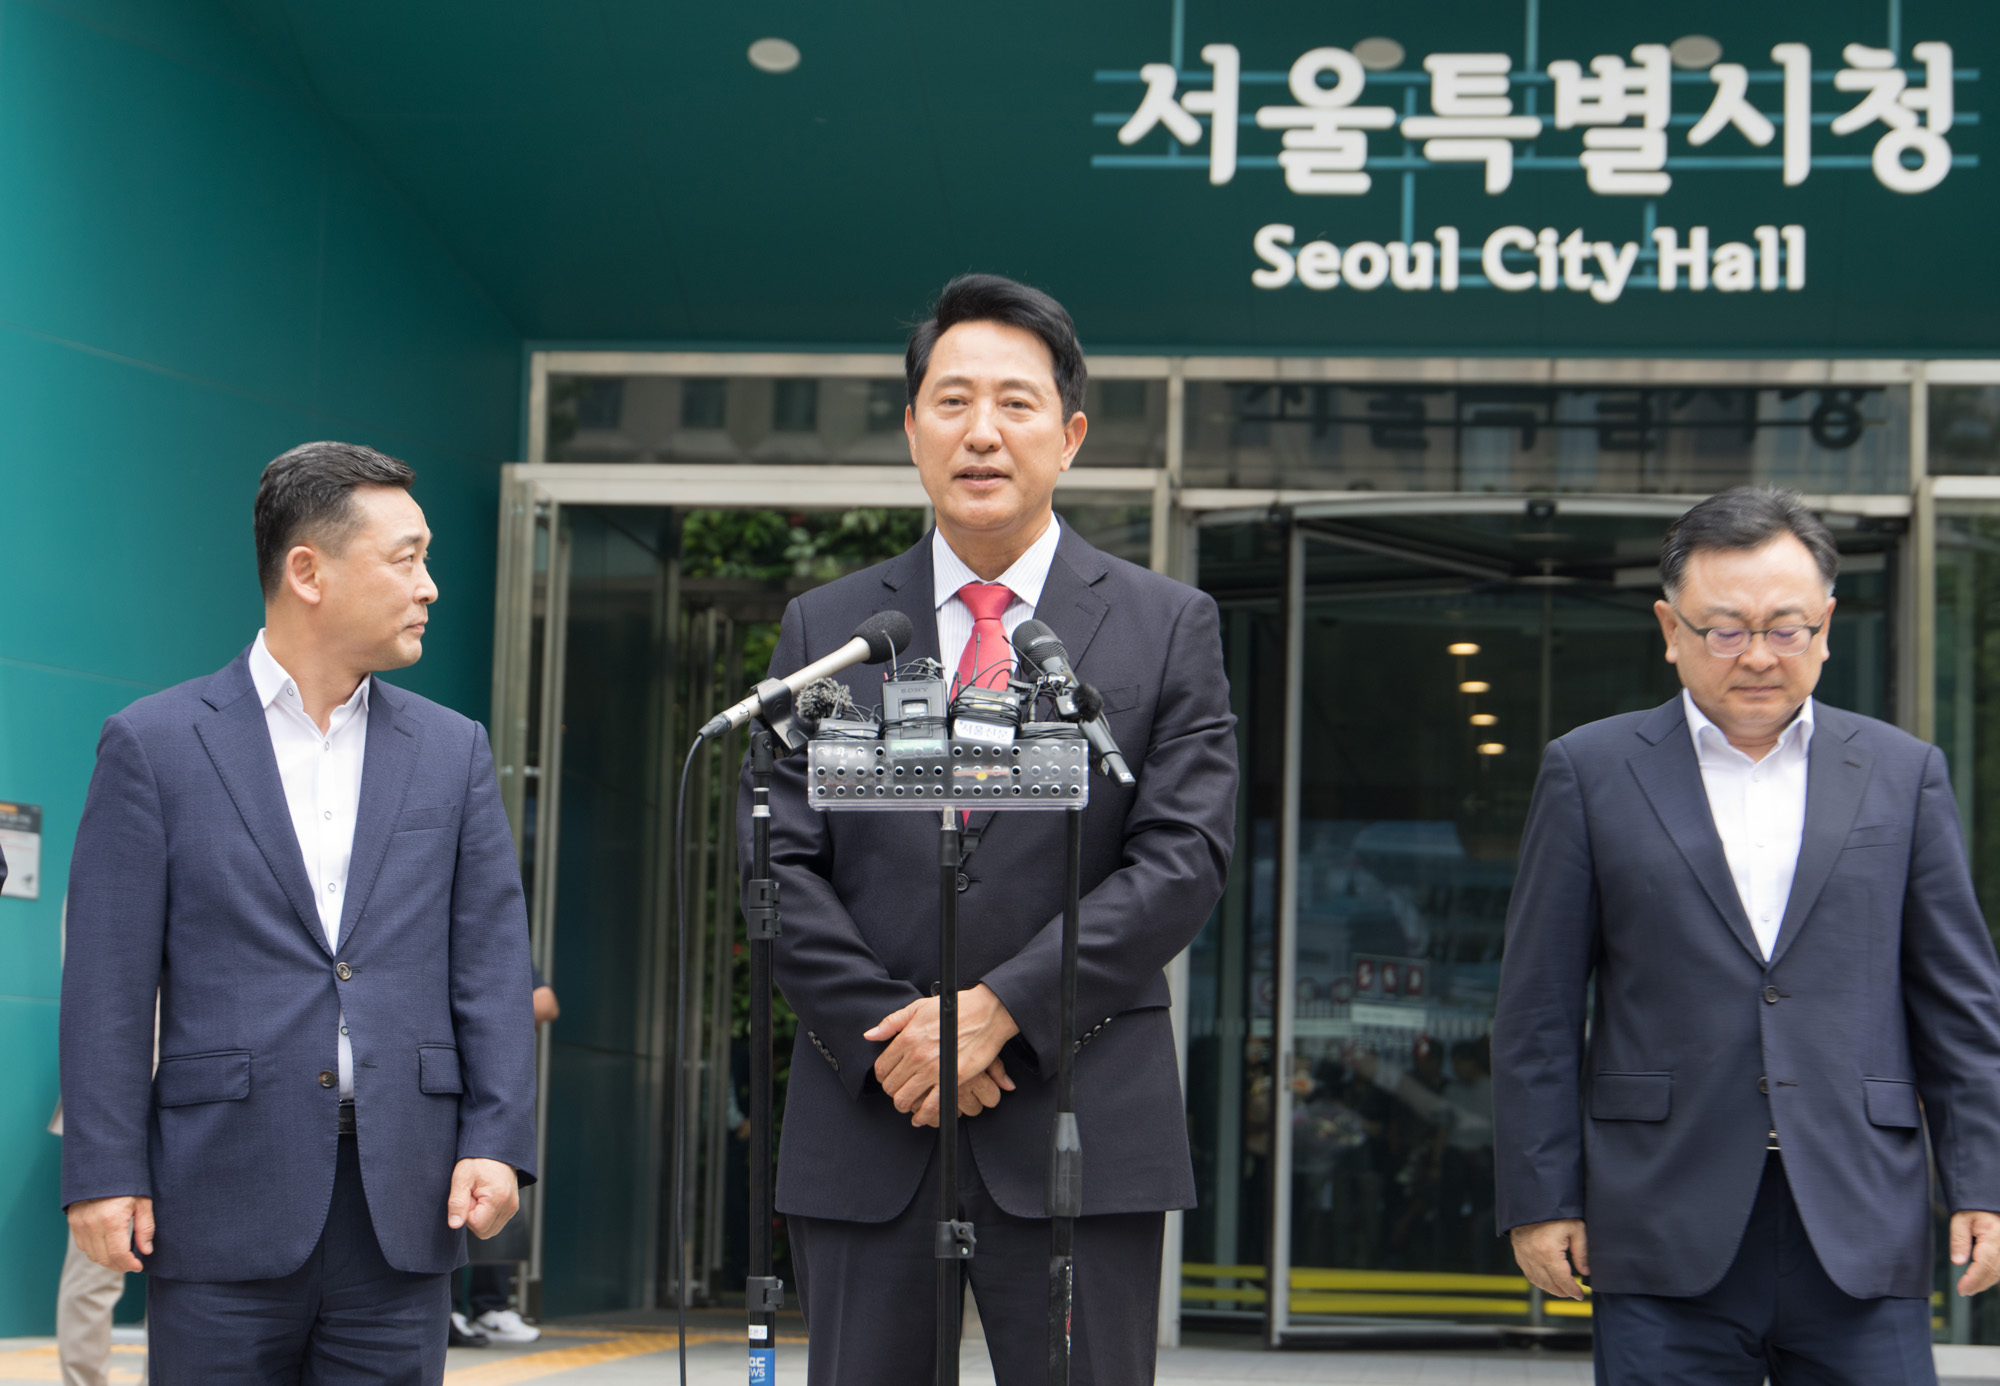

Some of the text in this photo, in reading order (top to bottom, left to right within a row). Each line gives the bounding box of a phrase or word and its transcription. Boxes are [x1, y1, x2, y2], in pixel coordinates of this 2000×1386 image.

[1118, 42, 1955, 195] 서울특별시청
[1252, 224, 1806, 303] Seoul City Hall
